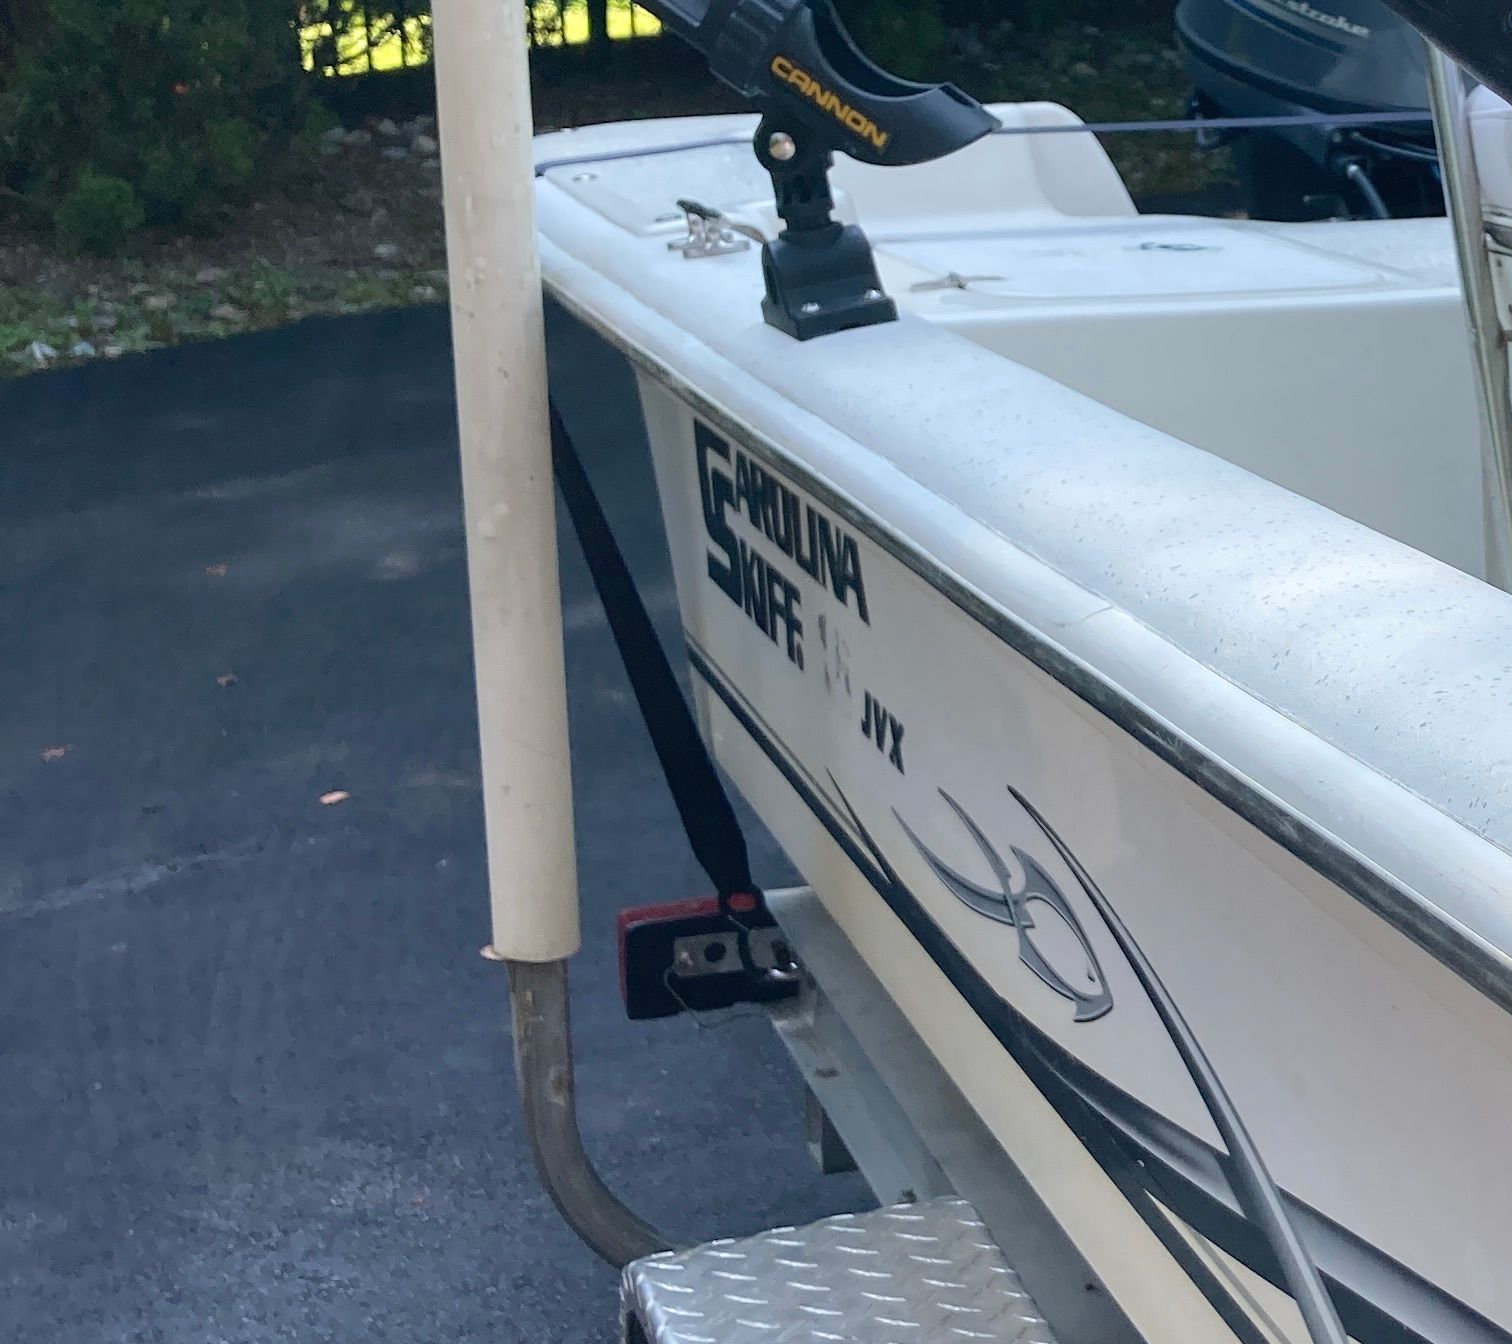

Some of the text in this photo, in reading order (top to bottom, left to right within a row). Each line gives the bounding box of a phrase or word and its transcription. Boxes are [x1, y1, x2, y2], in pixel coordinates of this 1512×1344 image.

[770, 55, 888, 148] CANNON
[694, 417, 871, 626] CAROLINA
[860, 688, 906, 777] JVX
